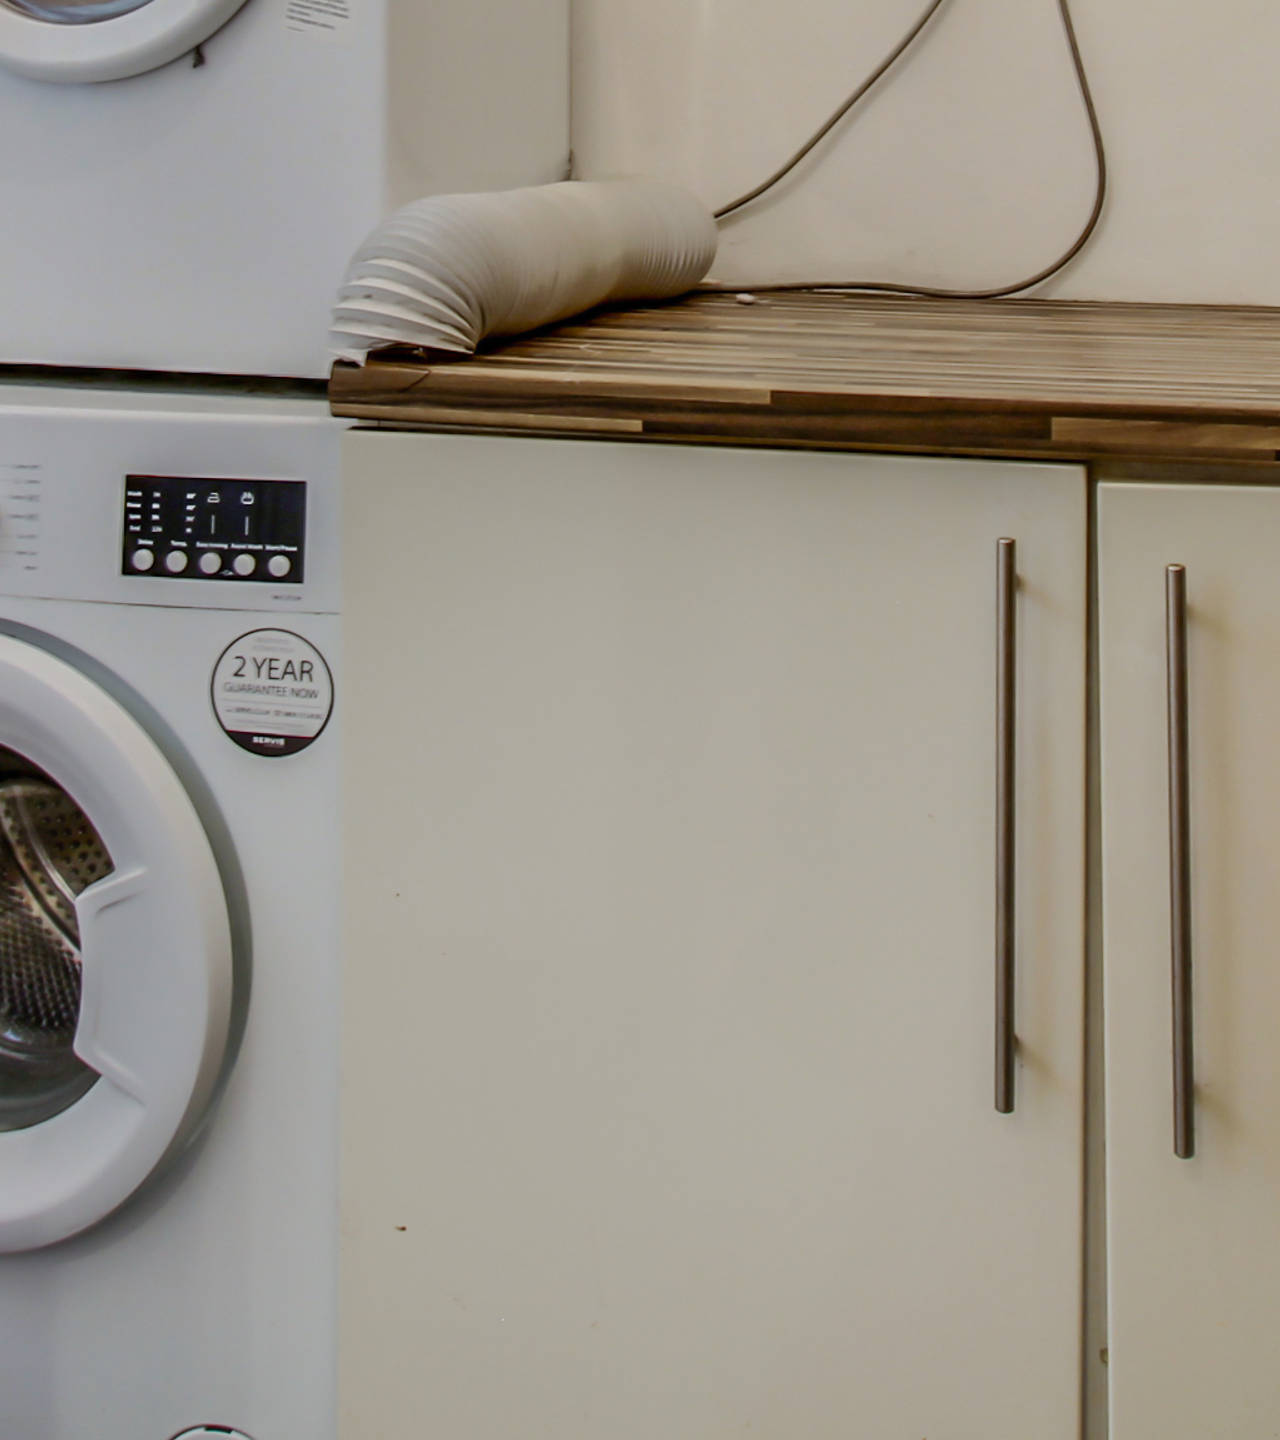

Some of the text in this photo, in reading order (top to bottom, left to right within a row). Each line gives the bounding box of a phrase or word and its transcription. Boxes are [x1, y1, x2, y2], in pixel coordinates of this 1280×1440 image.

[232, 655, 314, 682] 2 YEAR
[223, 681, 319, 700] GUARANTEE NOW
